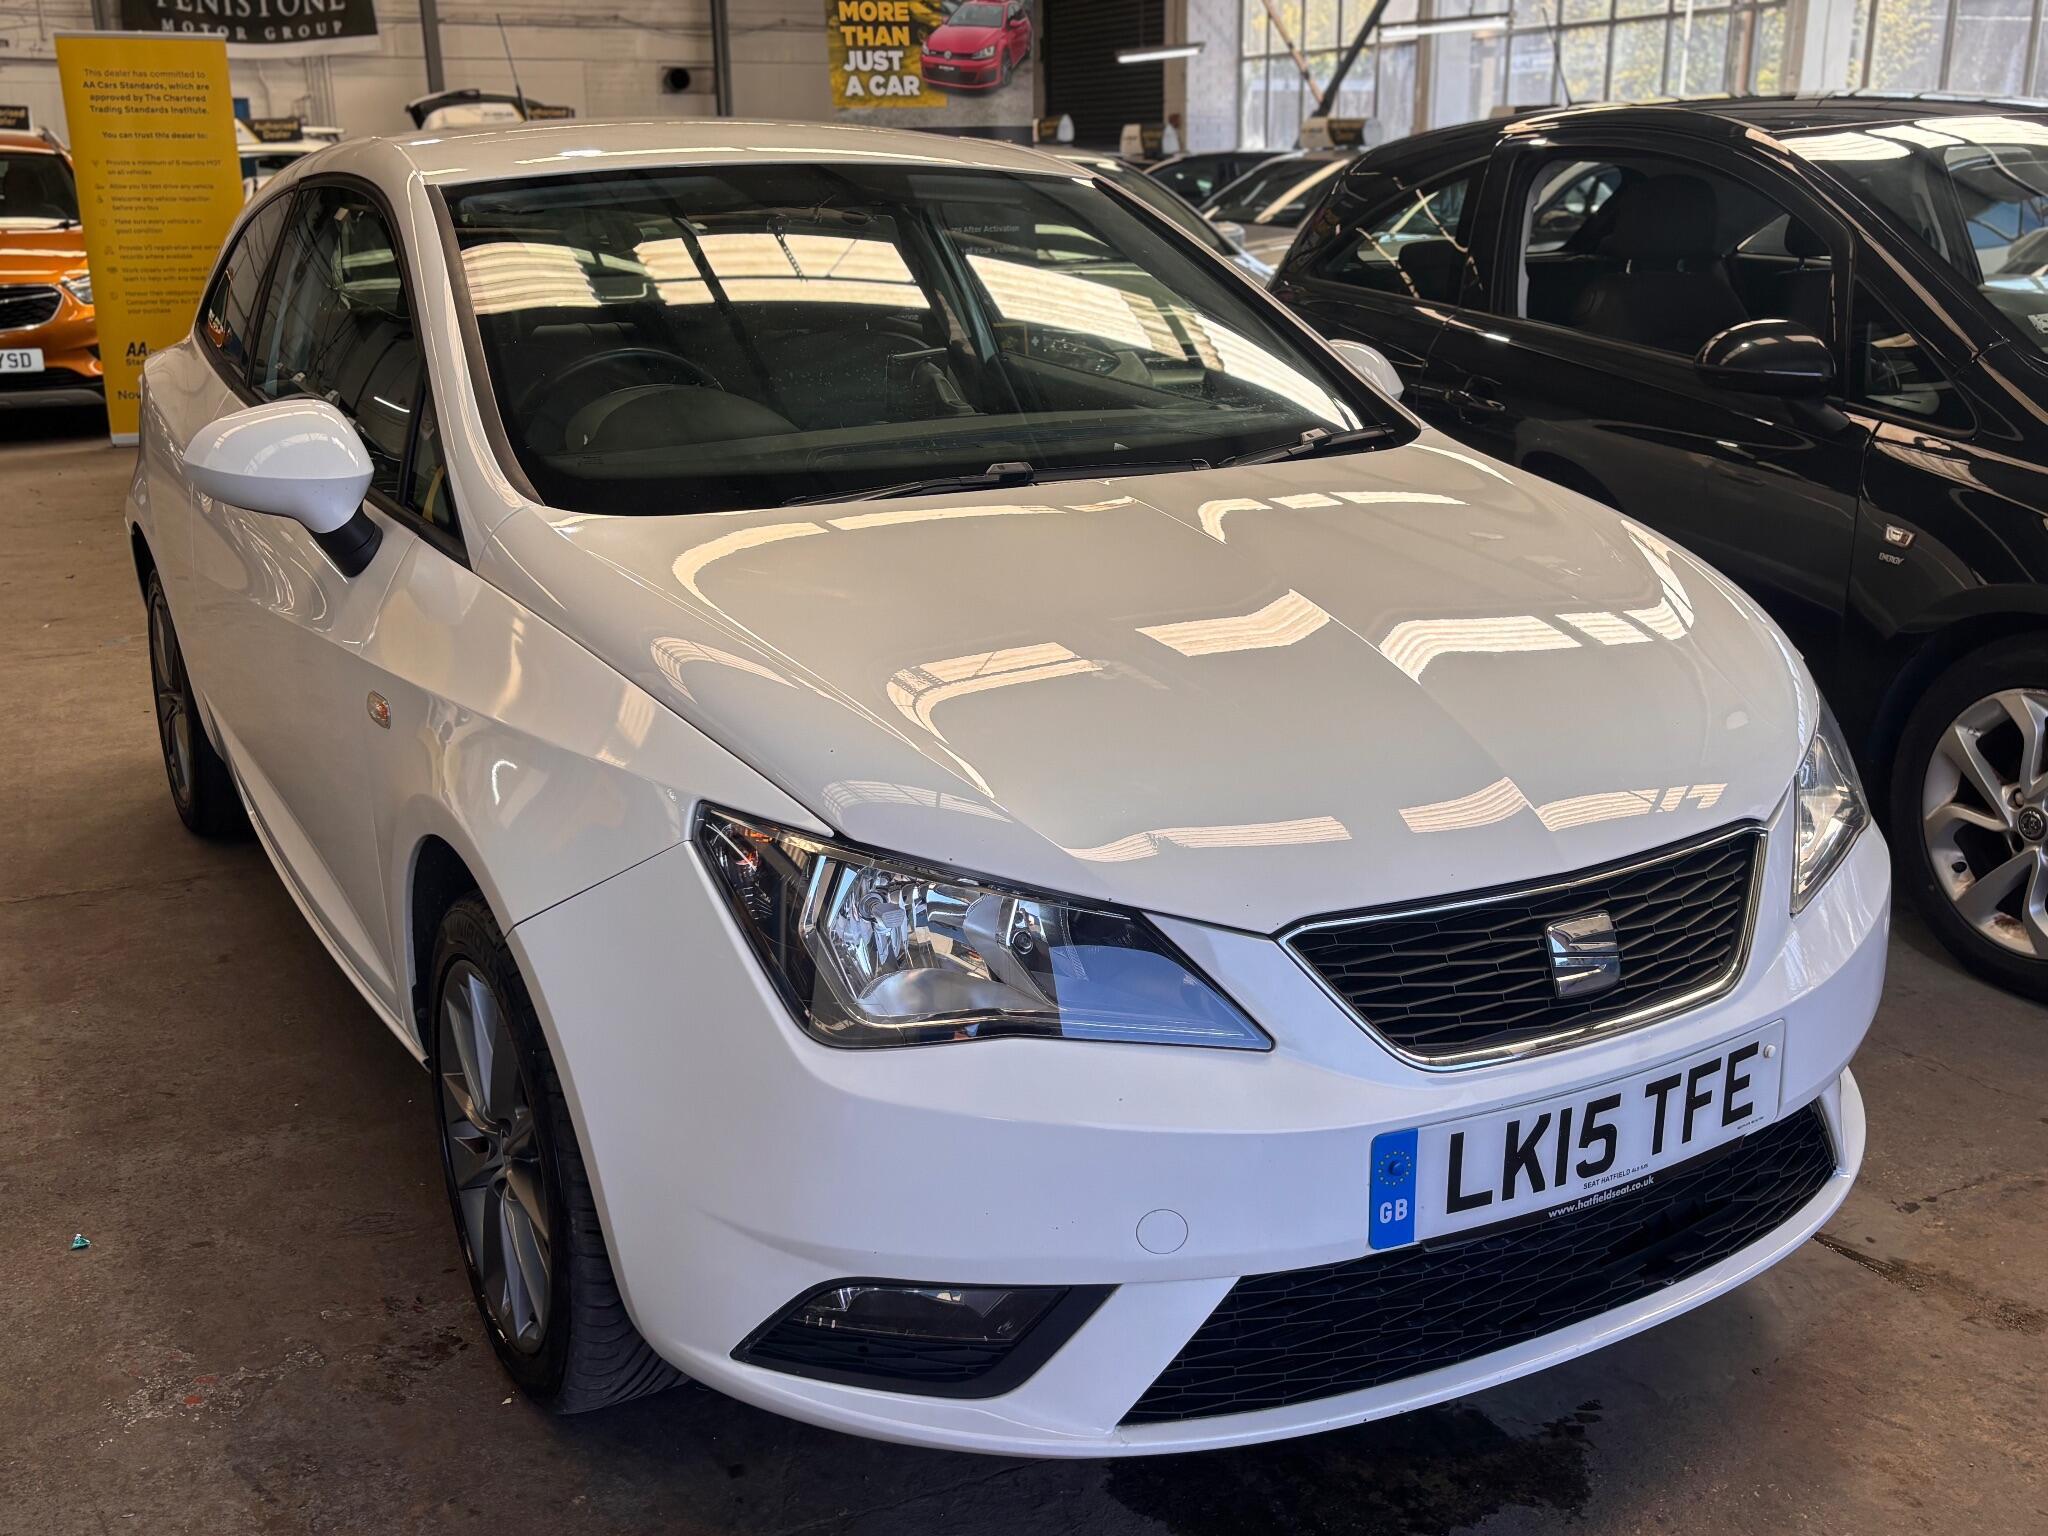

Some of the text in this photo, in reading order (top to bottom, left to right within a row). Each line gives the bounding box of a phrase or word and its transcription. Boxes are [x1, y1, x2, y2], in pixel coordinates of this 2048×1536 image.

[838, 1, 910, 22] MORE
[161, 18, 343, 40] MOTOR GROUP
[840, 26, 911, 47] THAN
[843, 50, 904, 72] JUST
[84, 69, 206, 79] This dealer has committed to
[83, 81, 96, 89] AA
[97, 81, 117, 89] Cars
[120, 82, 168, 91] Standards,
[169, 82, 194, 90] which
[845, 75, 921, 97] A CAR
[90, 94, 206, 103] approved by The Chartered
[90, 105, 123, 114] Trading
[124, 105, 169, 114] Standards
[102, 131, 117, 139] You
[155, 131, 169, 139] this
[171, 131, 196, 139] dealer
[126, 341, 148, 357] AA
[1446, 1041, 1760, 1215] LK15 TFE
[1583, 1178, 1600, 1190] SEAT
[1601, 1168, 1631, 1184] HATFIELD
[1548, 1175, 1655, 1218] www.hatfieldseat.co.uk
[1379, 1198, 1408, 1224] GB
